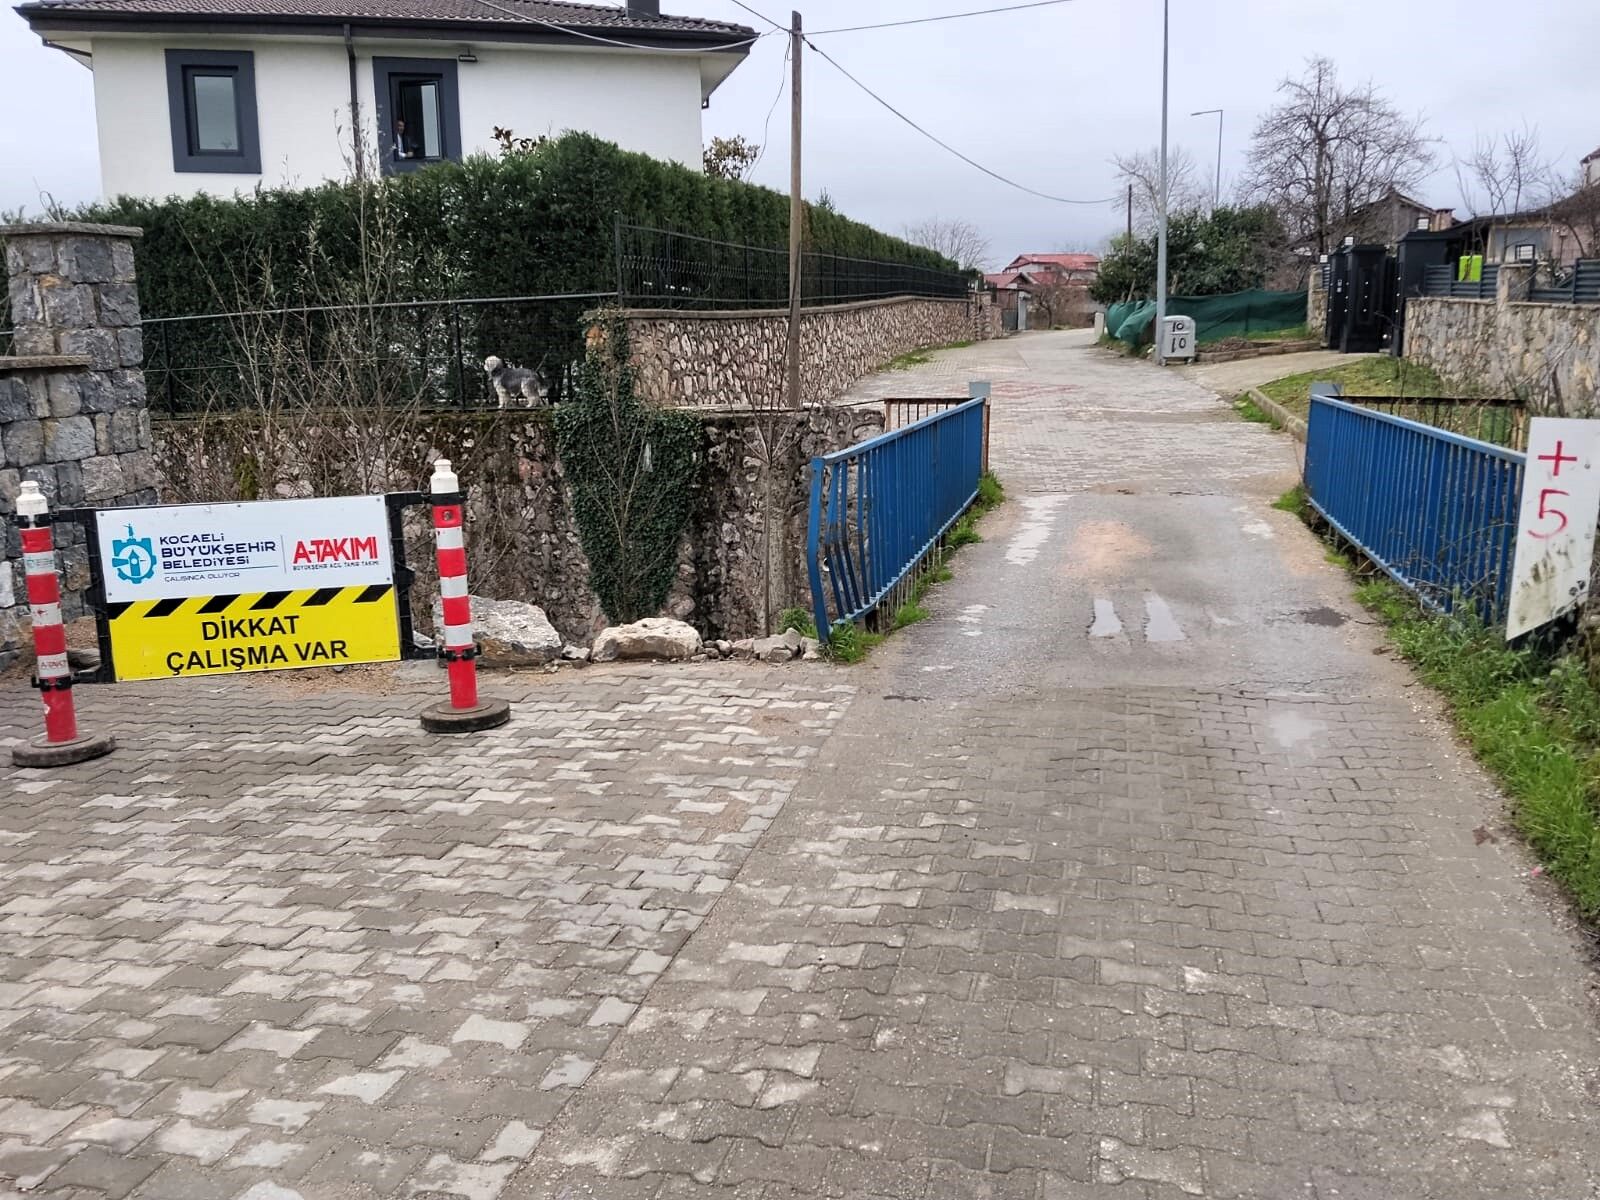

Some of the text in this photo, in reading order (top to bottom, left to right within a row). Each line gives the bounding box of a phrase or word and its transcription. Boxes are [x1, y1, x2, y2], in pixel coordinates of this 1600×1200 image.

[1172, 321, 1184, 332] 10
[1171, 337, 1187, 353] 10
[1527, 489, 1570, 539] 5
[160, 533, 224, 545] KOCAELİ
[161, 541, 276, 558] BÜYÜKŞEHİR
[293, 536, 378, 564] A-TAKIMI
[163, 556, 250, 569] BELEDİYESİ
[202, 615, 299, 641] DİKKAT
[166, 640, 349, 675] ÇALIŞMA VAR
